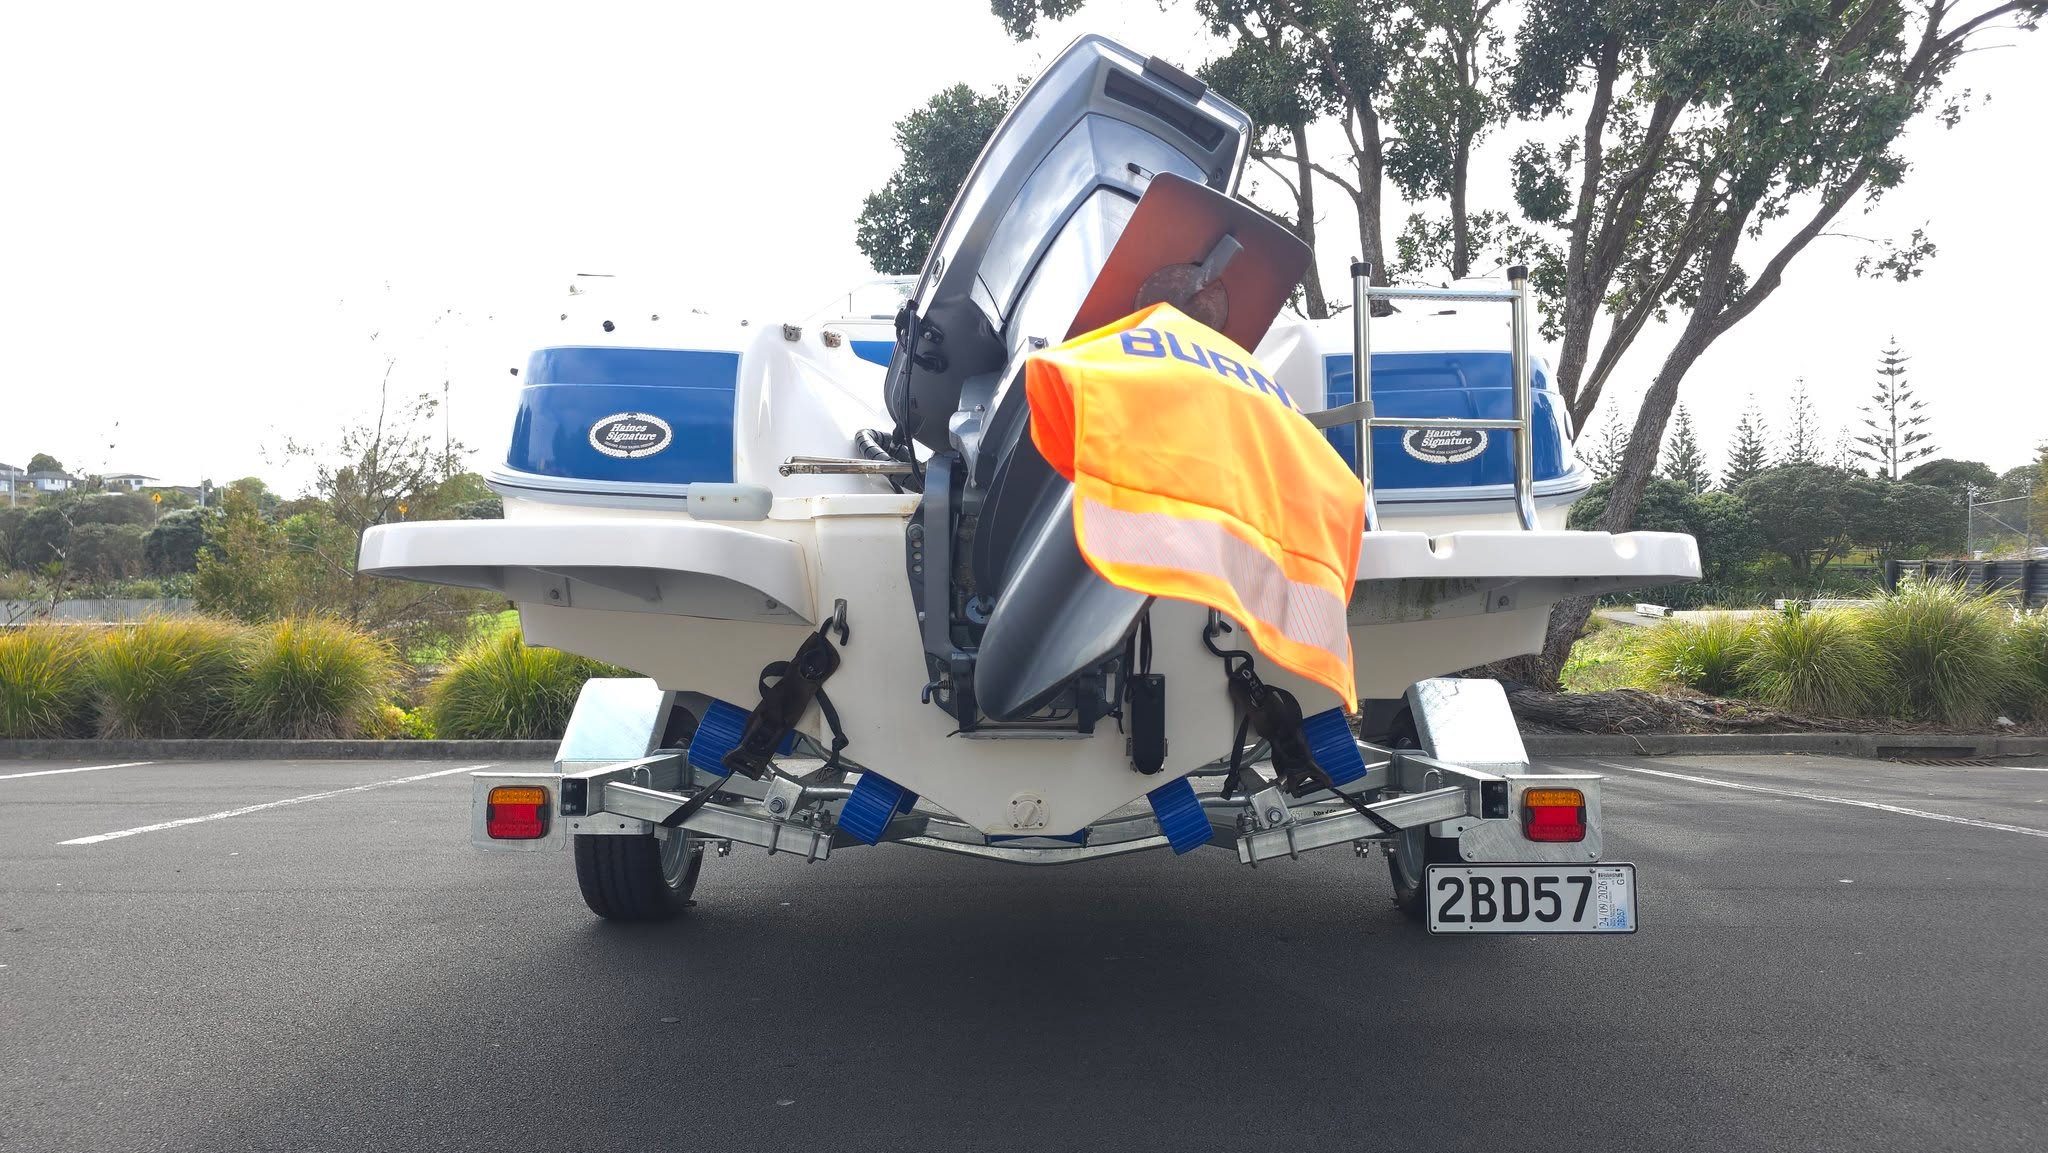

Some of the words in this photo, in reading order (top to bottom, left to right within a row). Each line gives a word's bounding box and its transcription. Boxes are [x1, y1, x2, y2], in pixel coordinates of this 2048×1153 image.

[1119, 327, 1305, 416] BURN
[606, 432, 656, 442] Signature
[1421, 437, 1473, 448] Signature
[1438, 876, 1592, 922] 2BD57
[1597, 880, 1609, 927] 24/09/2026
